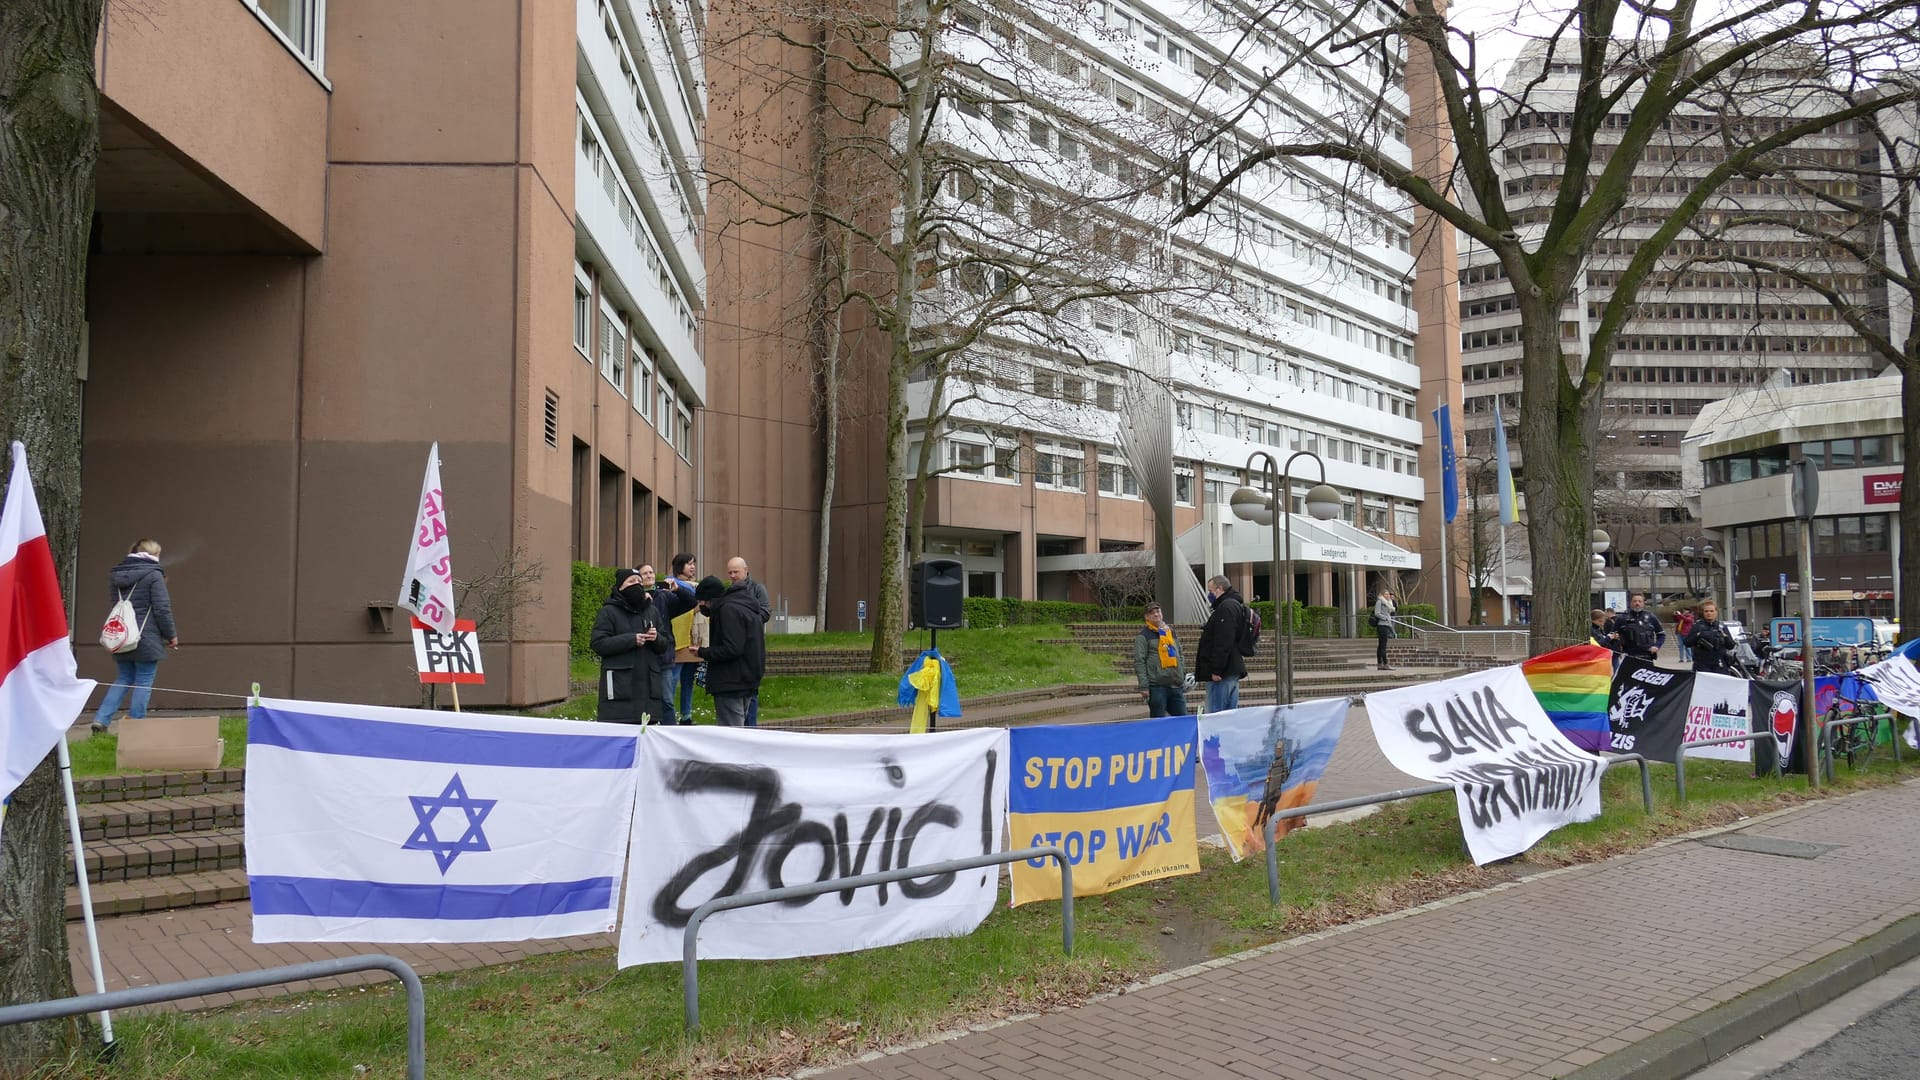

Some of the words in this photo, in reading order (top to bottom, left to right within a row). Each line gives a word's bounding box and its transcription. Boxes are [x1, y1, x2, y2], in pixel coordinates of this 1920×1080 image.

[423, 630, 472, 651] FCK
[427, 651, 476, 674] PTN
[1631, 668, 1674, 686] GEGEN
[1405, 685, 1537, 763] SLAVA
[1688, 705, 1712, 725] KEIN
[1682, 725, 1747, 750] RASSISMUS
[1023, 756, 1102, 789] STOP
[1109, 743, 1191, 786] PUTIN
[1026, 829, 1106, 869] STOP
[1140, 867, 1153, 877] War
[1162, 863, 1190, 873] Ukraine
